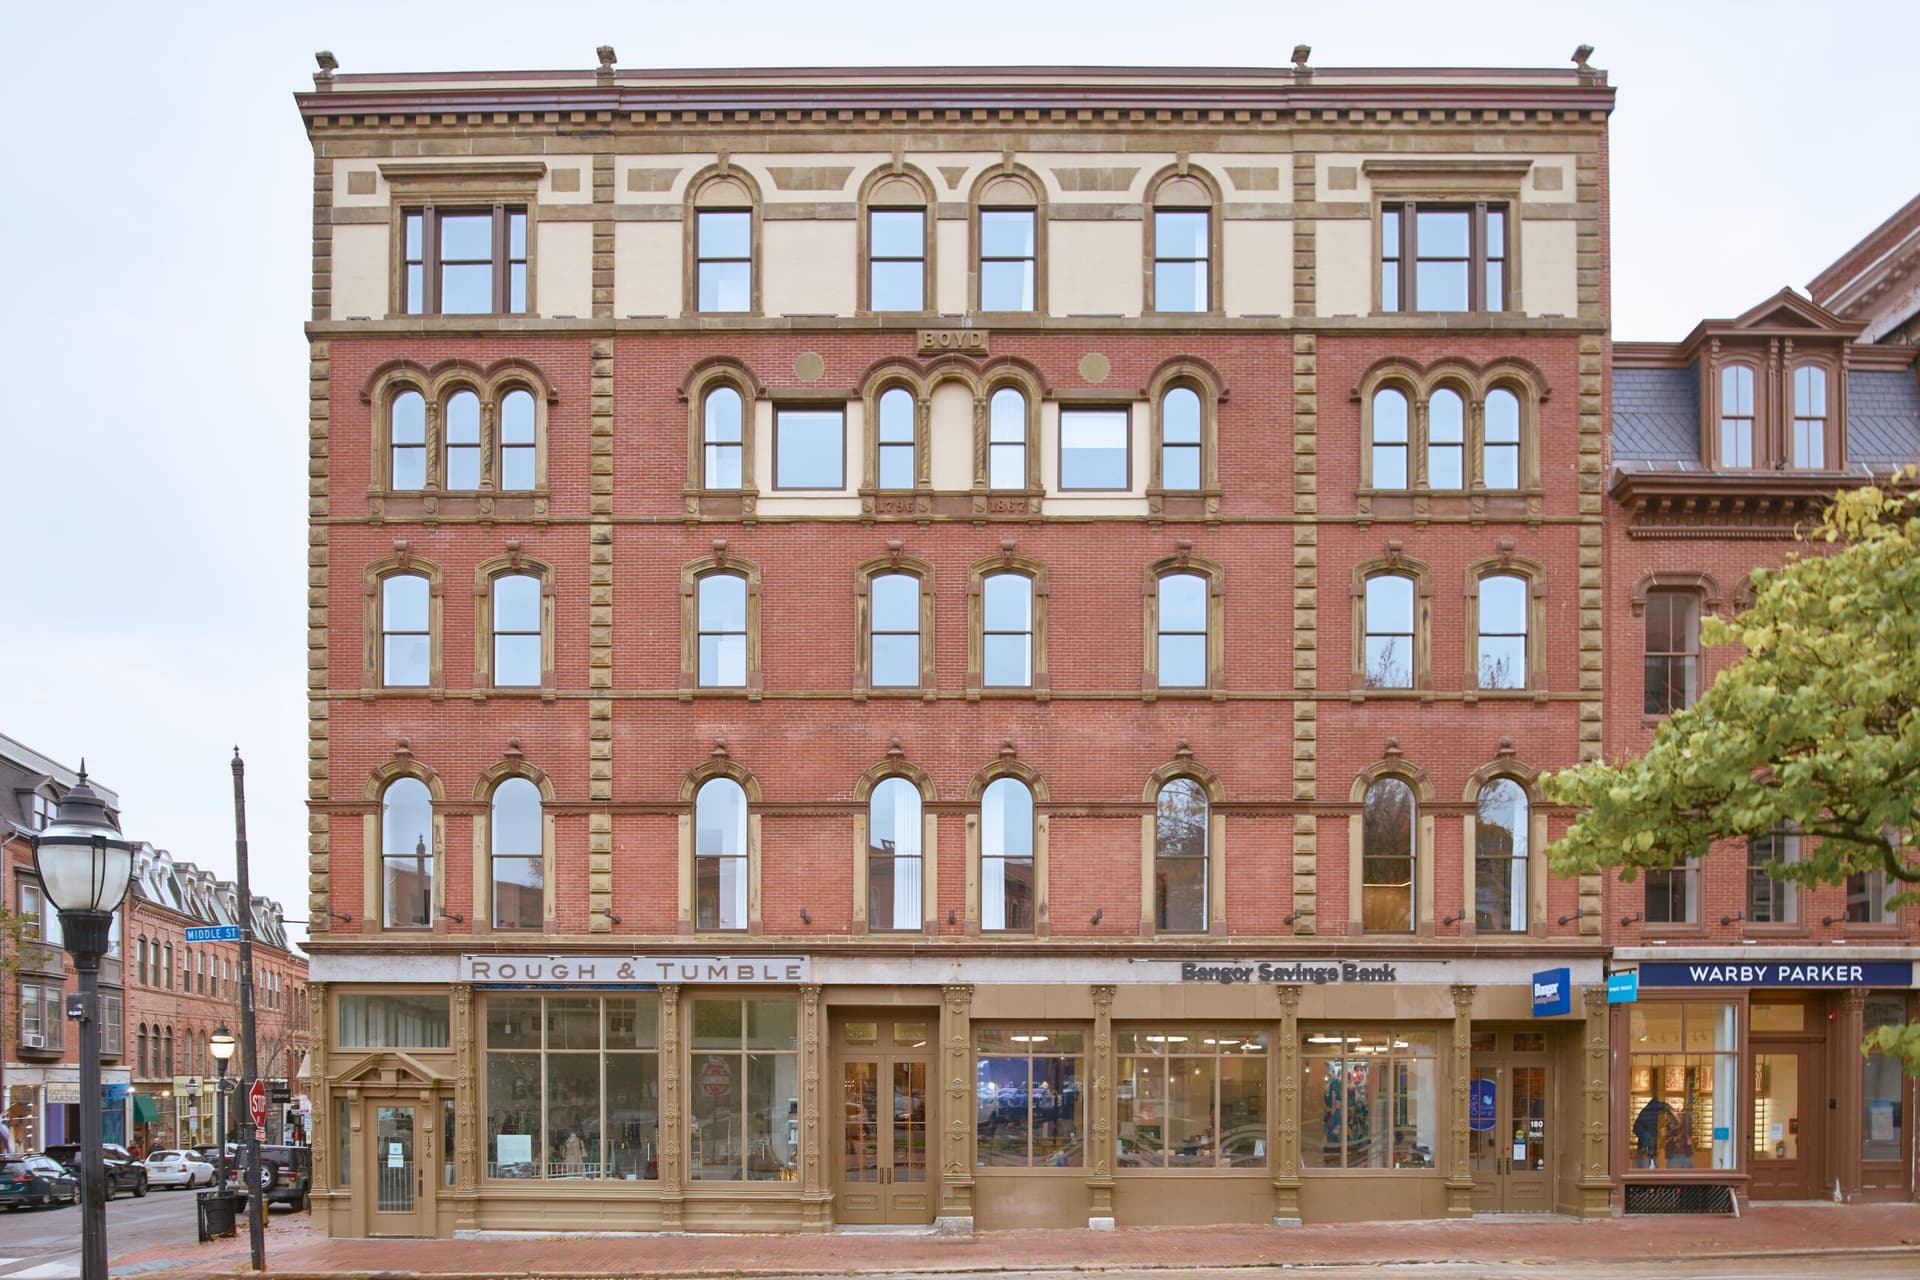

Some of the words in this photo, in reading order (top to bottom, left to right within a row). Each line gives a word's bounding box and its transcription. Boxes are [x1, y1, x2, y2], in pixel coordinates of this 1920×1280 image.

[924, 331, 981, 348] BOYD
[877, 500, 914, 513] 1796
[990, 500, 1026, 513] 1867
[187, 929, 221, 940] MIDDLE
[225, 927, 236, 938] ST
[471, 961, 596, 980] ROUGH
[616, 962, 636, 980] &
[655, 962, 802, 980] TUMBLE
[1181, 962, 1254, 984] Bangor
[1258, 962, 1339, 984] Savings
[1342, 963, 1397, 981] Bank
[1689, 965, 1768, 982] WARBY
[1778, 965, 1864, 982] PARKER
[252, 1094, 266, 1112] STOP
[1530, 1120, 1543, 1128] 180
